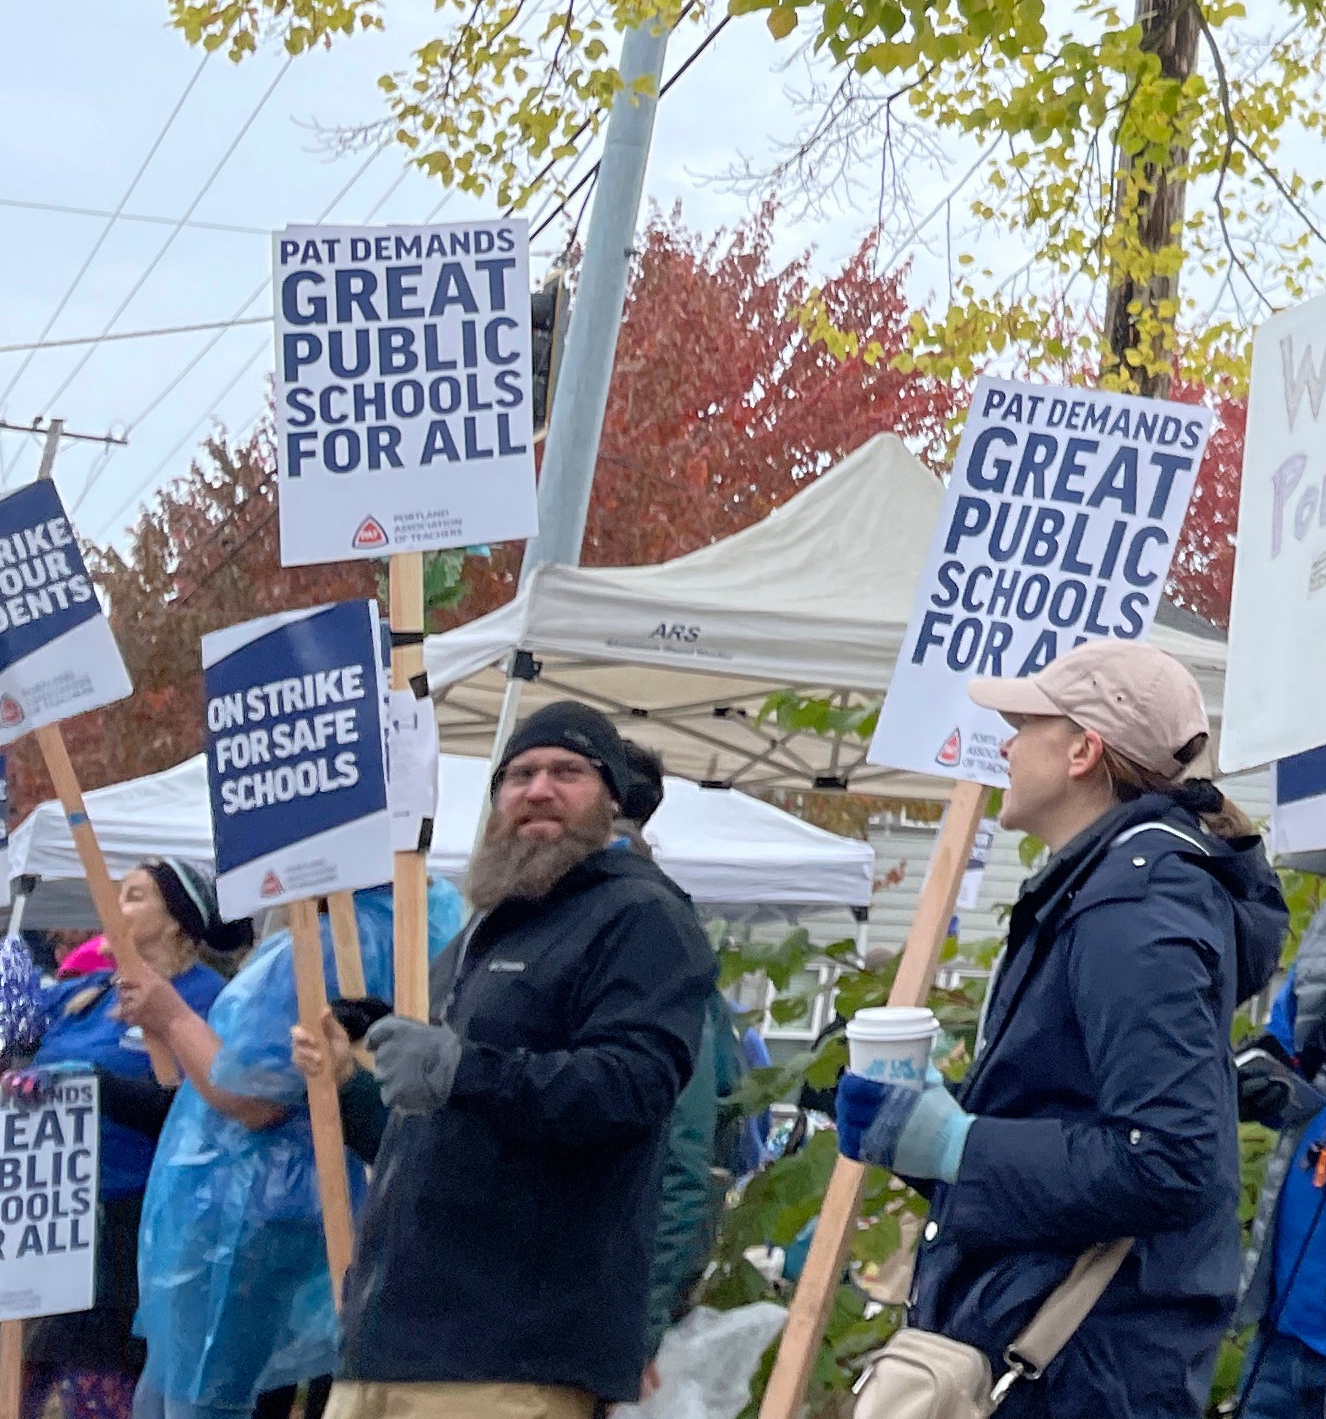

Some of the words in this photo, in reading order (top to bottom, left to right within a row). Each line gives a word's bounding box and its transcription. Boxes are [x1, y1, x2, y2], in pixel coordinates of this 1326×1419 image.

[281, 238, 340, 265] PAT
[350, 228, 515, 262] DEMANDS
[282, 258, 516, 325] GREAT
[284, 317, 521, 381] PUBLIC
[286, 370, 524, 427] SCHOOLS
[983, 389, 1044, 425] PAT
[1047, 398, 1203, 450] DEMANDS
[287, 424, 405, 478] FOR
[419, 413, 527, 466] ALL
[966, 426, 1193, 520] GREAT
[0, 549, 72, 596] OUR
[944, 495, 1169, 587] PUBLIC
[931, 560, 1149, 639] SCHOOLS
[912, 610, 1013, 678] FOR
[207, 692, 245, 732] ON
[247, 664, 365, 722] STRIKE
[215, 729, 272, 774] FOR
[272, 708, 360, 759] SAFE
[221, 751, 359, 815] SCHOOLS
[3, 1106, 93, 1153] EAT
[0, 1149, 91, 1192] BLIC
[1, 1187, 91, 1225] OOLS
[16, 1219, 90, 1259] ALL
